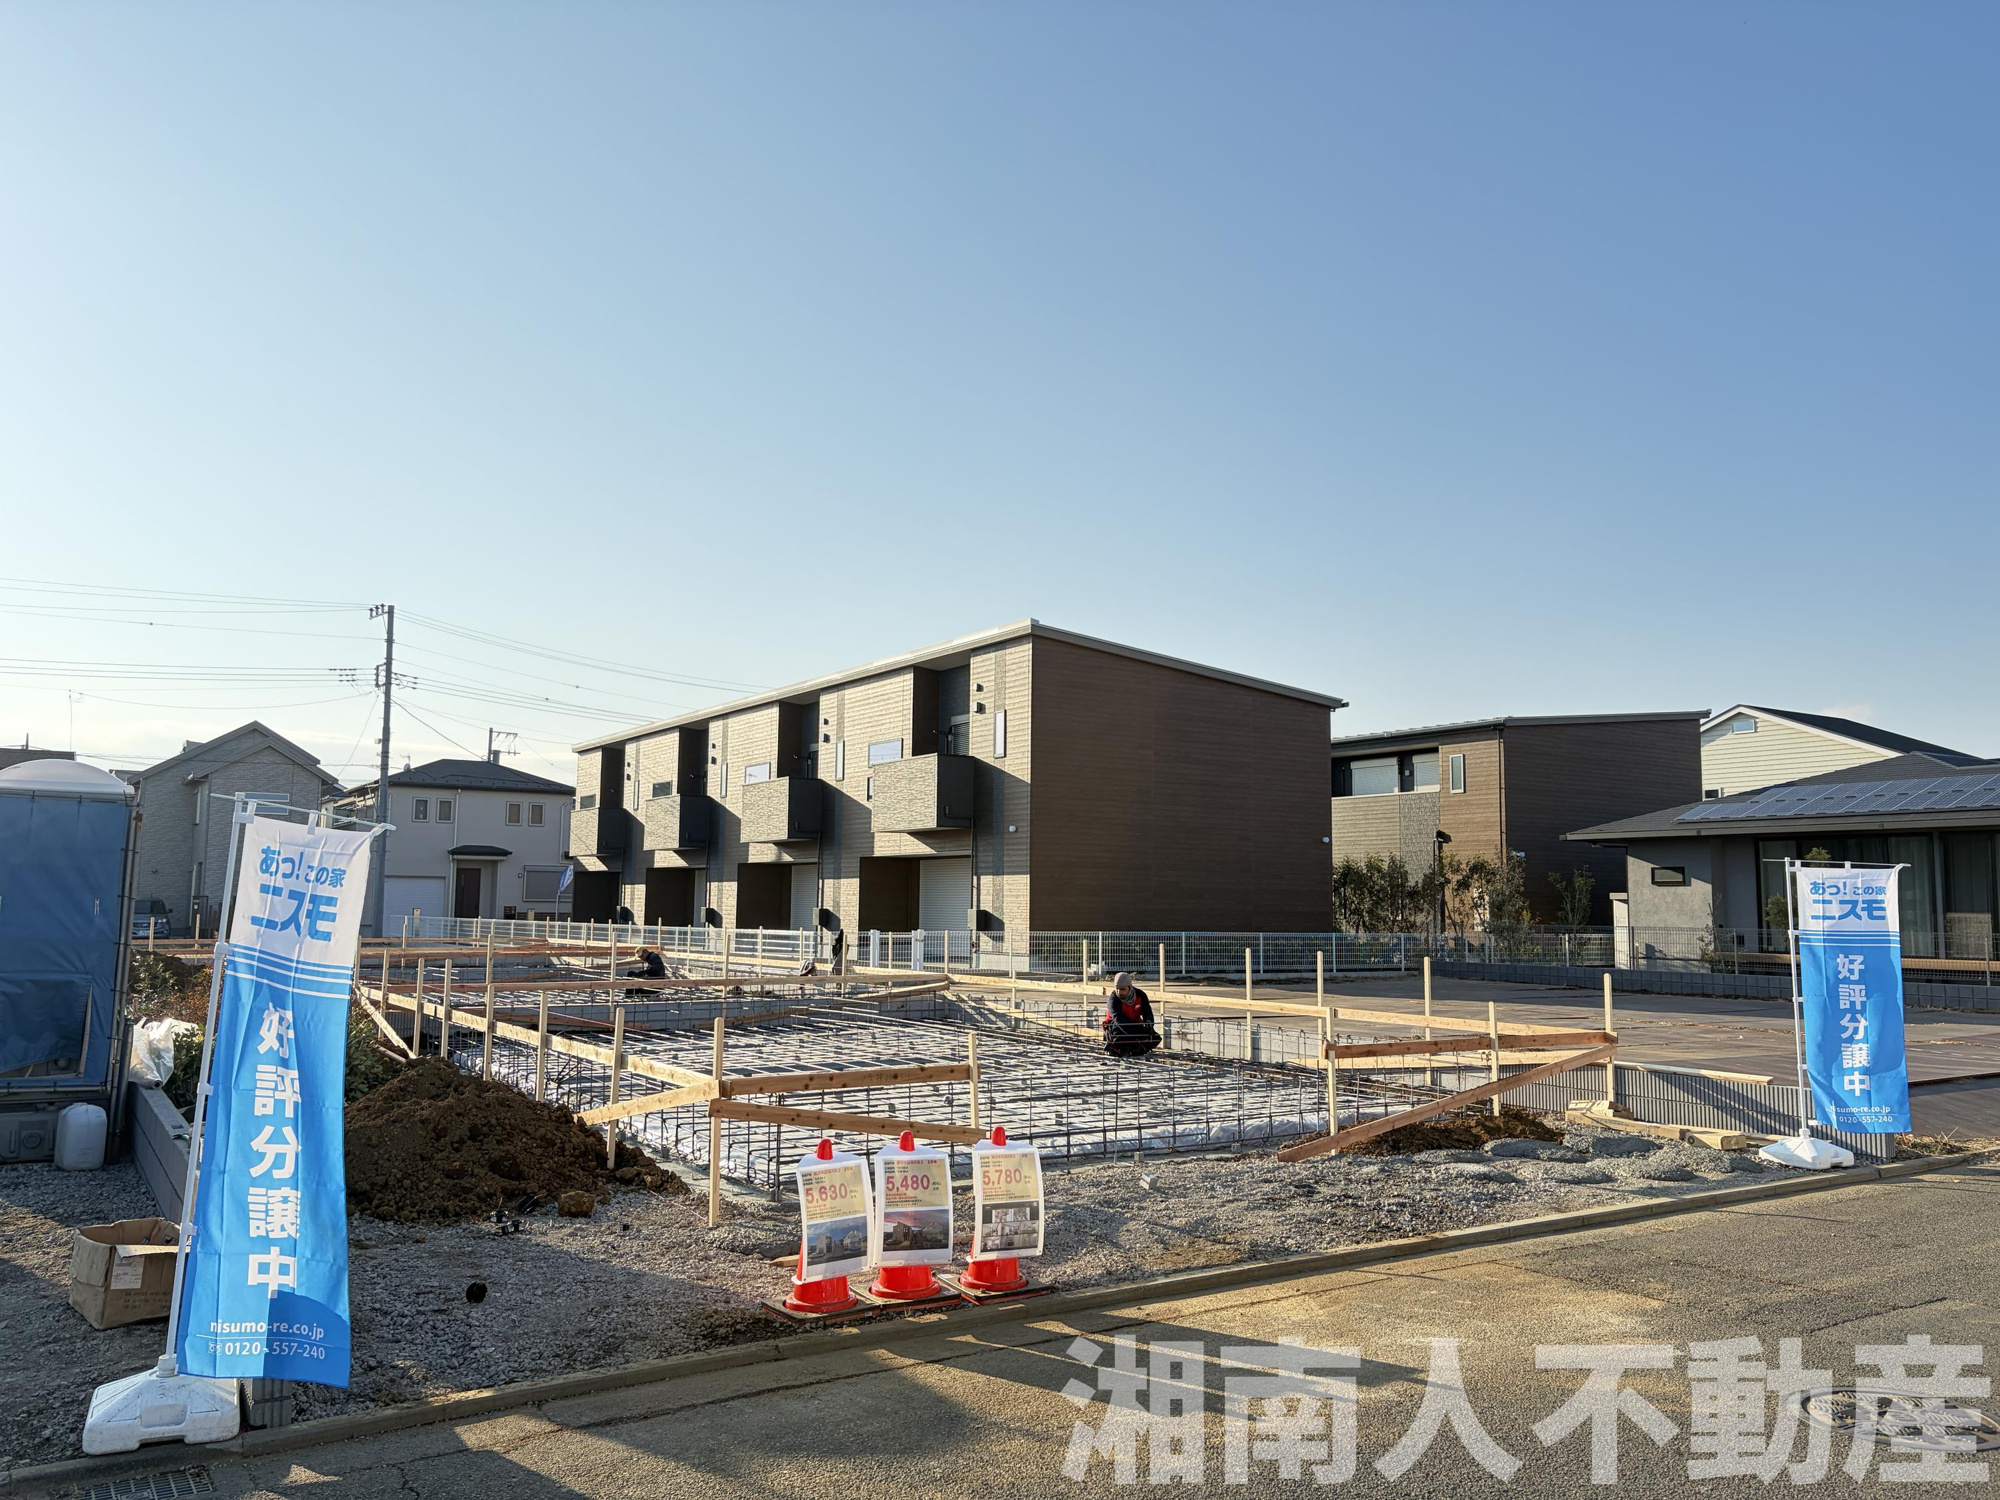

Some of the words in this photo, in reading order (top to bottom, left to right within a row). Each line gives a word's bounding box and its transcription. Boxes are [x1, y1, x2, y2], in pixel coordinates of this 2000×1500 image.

[250, 883, 338, 942] ニスモ
[1810, 899, 1887, 921] ニスモ
[1836, 953, 1871, 1097] 好評分譲中
[247, 1001, 302, 1299] 好評分譲中
[886, 1174, 930, 1192] 5,480
[982, 1168, 1022, 1186] 5,780
[210, 1319, 325, 1340] nisumo-re.co.jp
[224, 1341, 325, 1359] 0120-557-240
